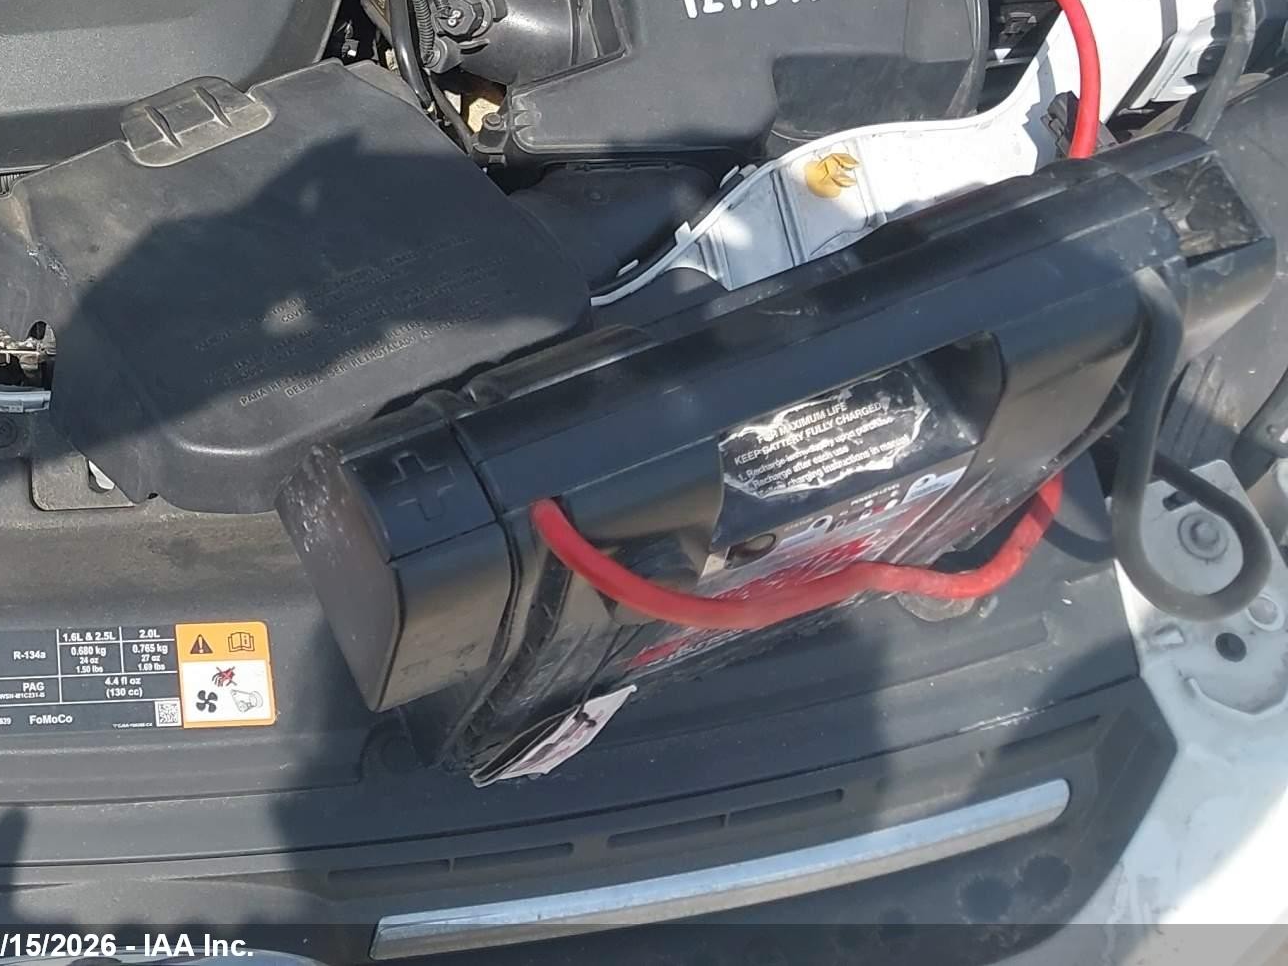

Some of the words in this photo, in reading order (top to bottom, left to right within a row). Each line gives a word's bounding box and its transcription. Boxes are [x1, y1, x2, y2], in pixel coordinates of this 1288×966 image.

[826, 401, 848, 416] LIFE
[734, 448, 761, 466] KEEP
[761, 431, 806, 455] BATTERY
[804, 419, 835, 438] FULLY
[834, 401, 882, 426] CHARGED
[62, 633, 84, 642] 1.6L
[85, 632, 93, 641] &
[95, 631, 116, 641] 2.5L
[139, 629, 160, 638] 2.0L
[71, 646, 93, 656] 0.680
[95, 646, 107, 656] kg
[132, 644, 155, 654] 0.765
[157, 644, 168, 654] kg
[13, 650, 46, 661] R-134a
[92, 665, 103, 673] lbs
[154, 663, 166, 671] lbs
[22, 681, 45, 692] PAG
[105, 677, 120, 685] 4.4
[129, 677, 142, 685] oz
[106, 688, 126, 698] (130
[128, 687, 143, 698] cc)
[29, 714, 73, 725] FoMoCo
